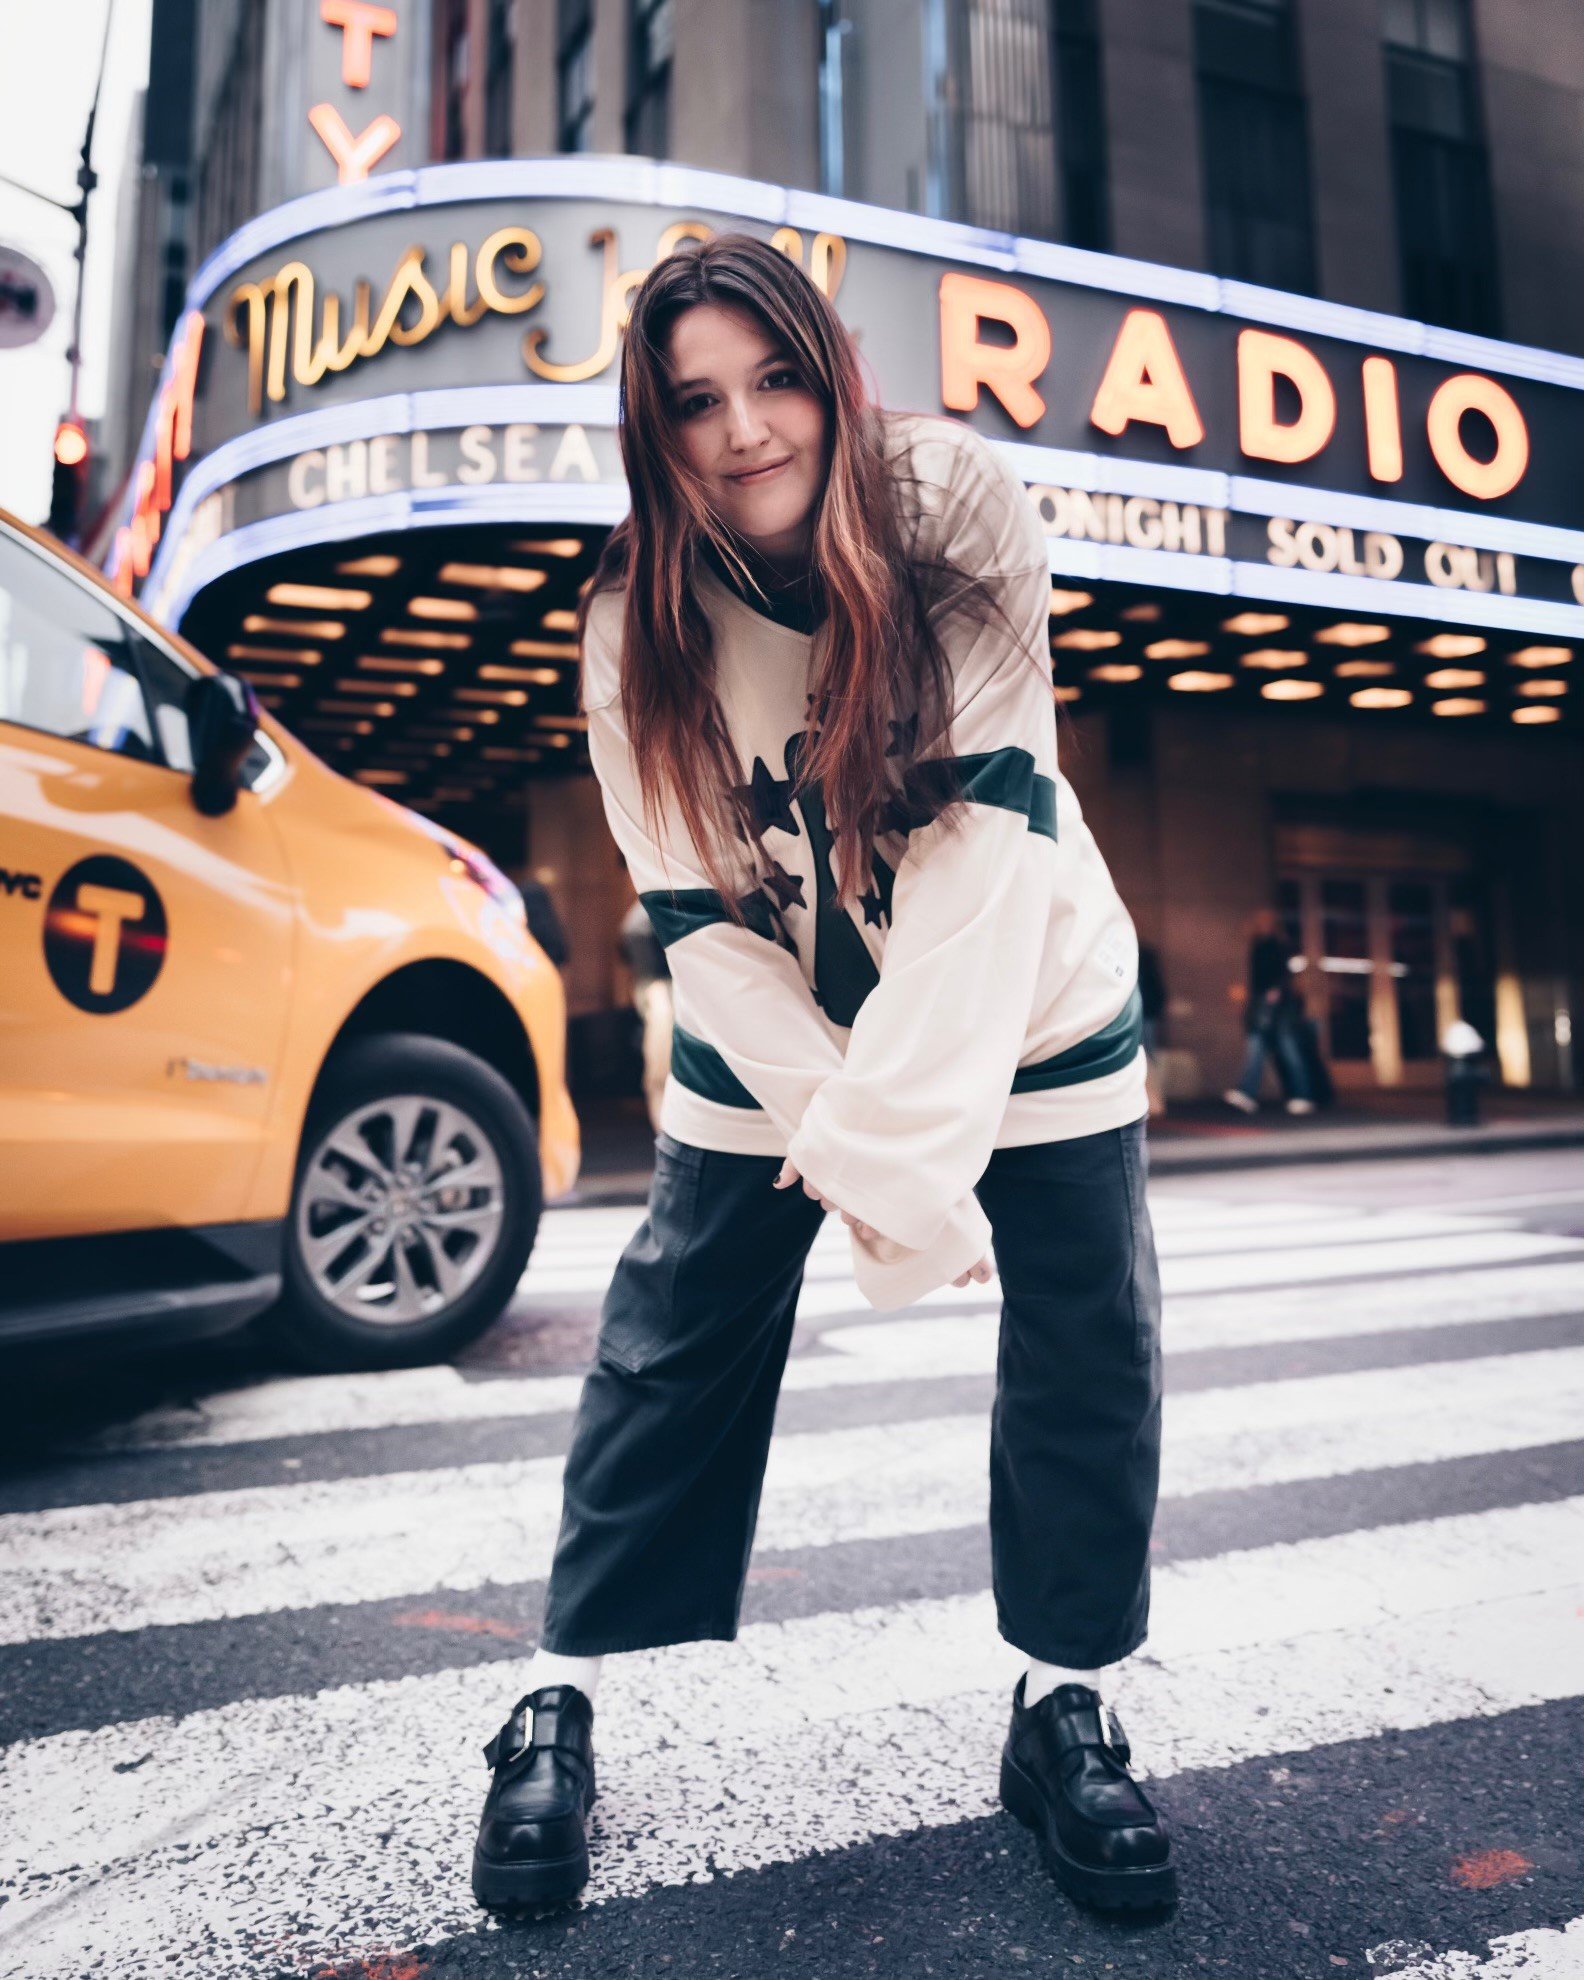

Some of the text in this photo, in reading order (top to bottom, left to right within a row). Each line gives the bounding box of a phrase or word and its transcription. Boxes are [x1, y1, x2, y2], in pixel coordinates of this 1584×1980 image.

[939, 272, 1529, 499] RADIO
[288, 424, 600, 509] CHELSEA
[1026, 484, 1228, 557] ONIGHT
[1267, 517, 1404, 580] SOLD
[1425, 542, 1517, 596] OUT
[75, 882, 145, 996] T
